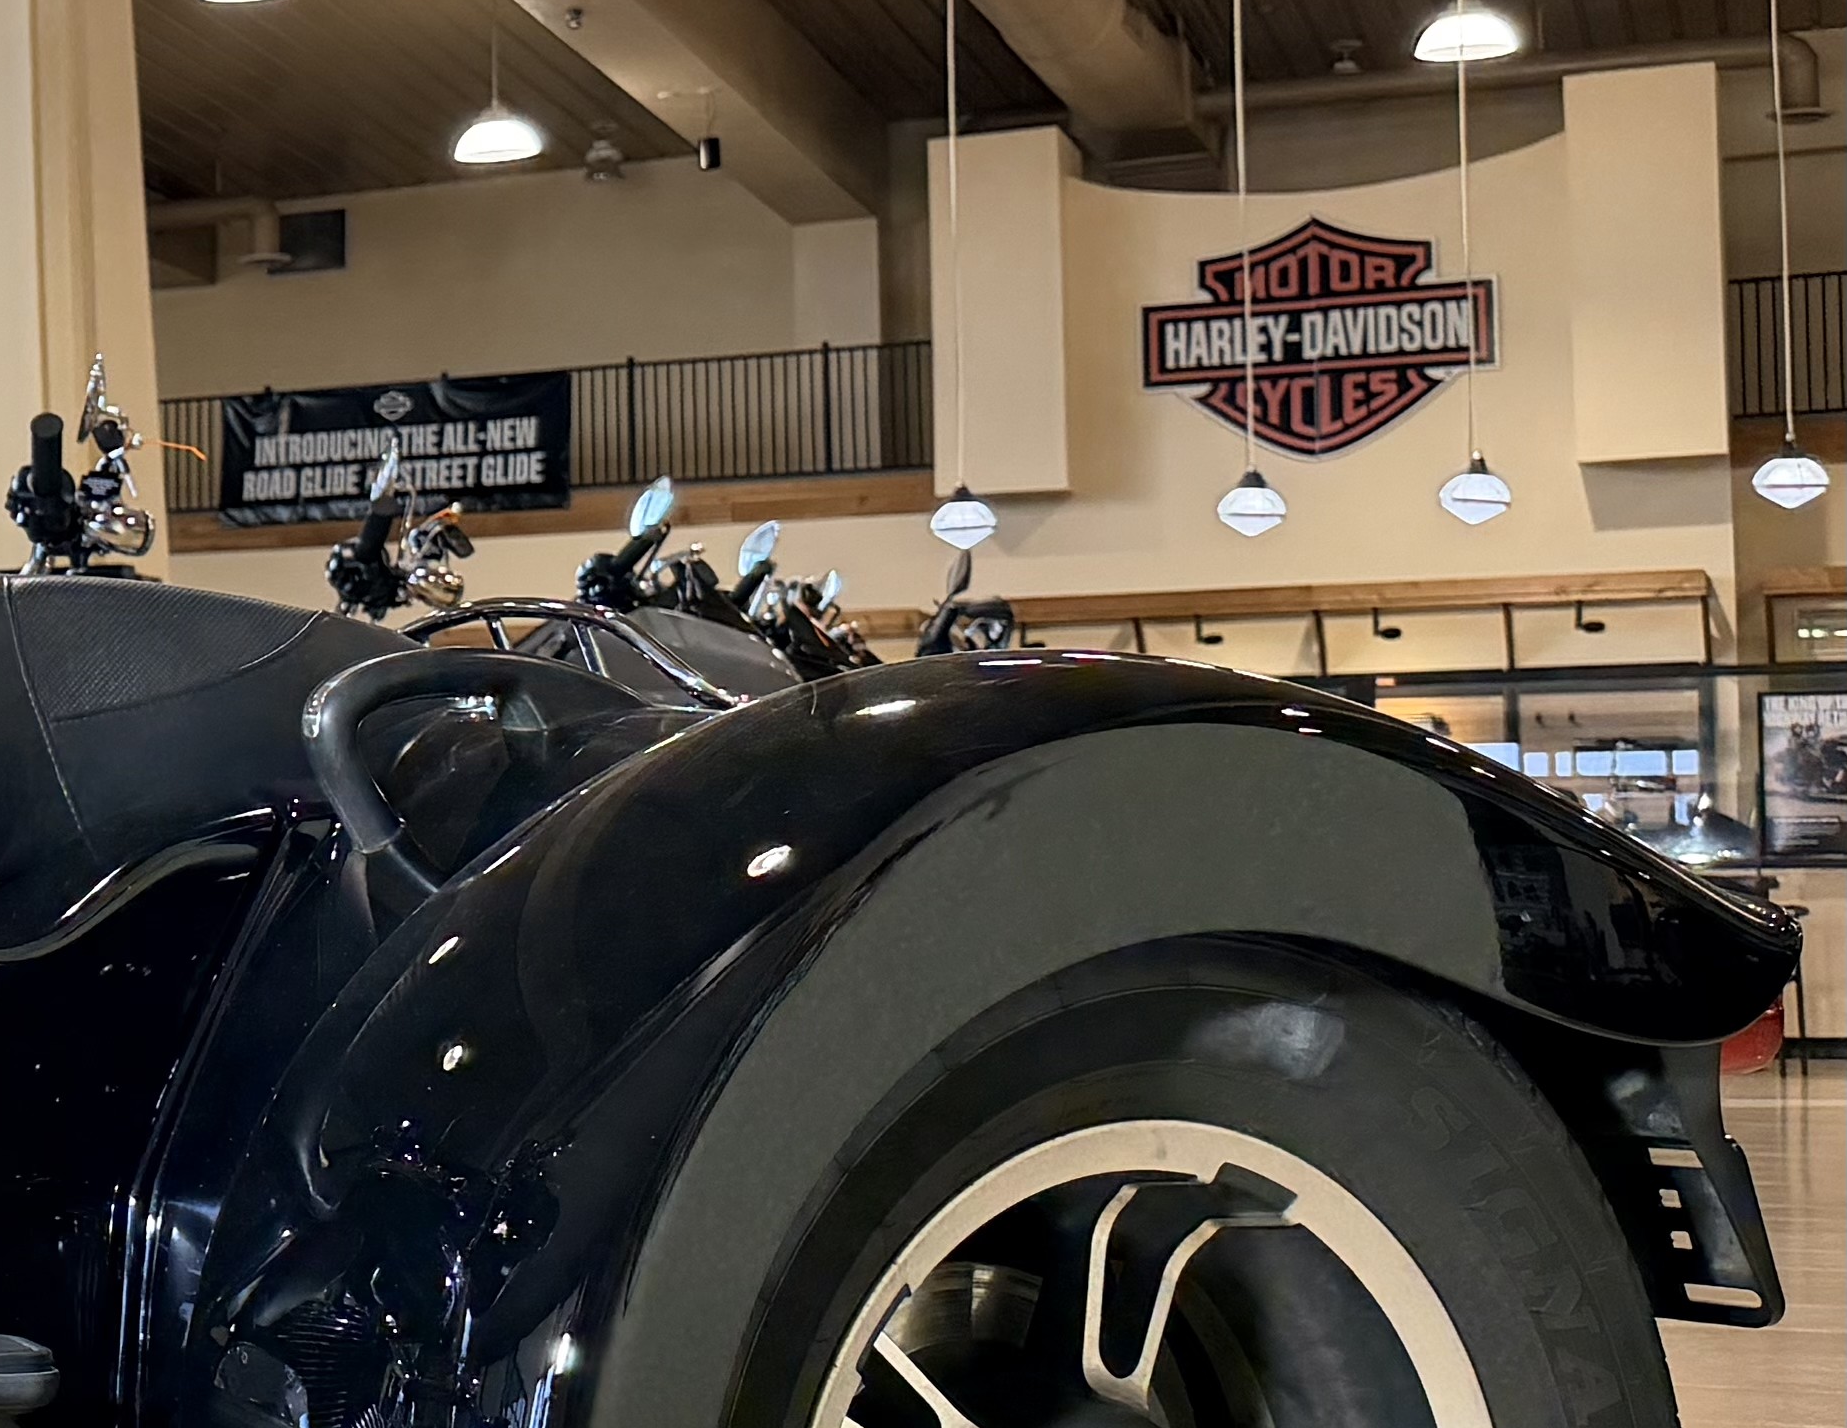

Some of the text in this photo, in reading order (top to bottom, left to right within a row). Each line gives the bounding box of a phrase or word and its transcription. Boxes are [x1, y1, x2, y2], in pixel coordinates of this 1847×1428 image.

[1234, 239, 1398, 301] MOTOR
[1163, 299, 1472, 370] HARLEY-DAVIDSON
[1234, 370, 1399, 438] CYCLES
[397, 422, 440, 458] THE
[441, 415, 540, 455] ALL-NEW
[241, 470, 298, 503] ROAD
[299, 463, 363, 499] GLIDE
[400, 456, 480, 490] STREET
[480, 451, 548, 487] GLIDE
